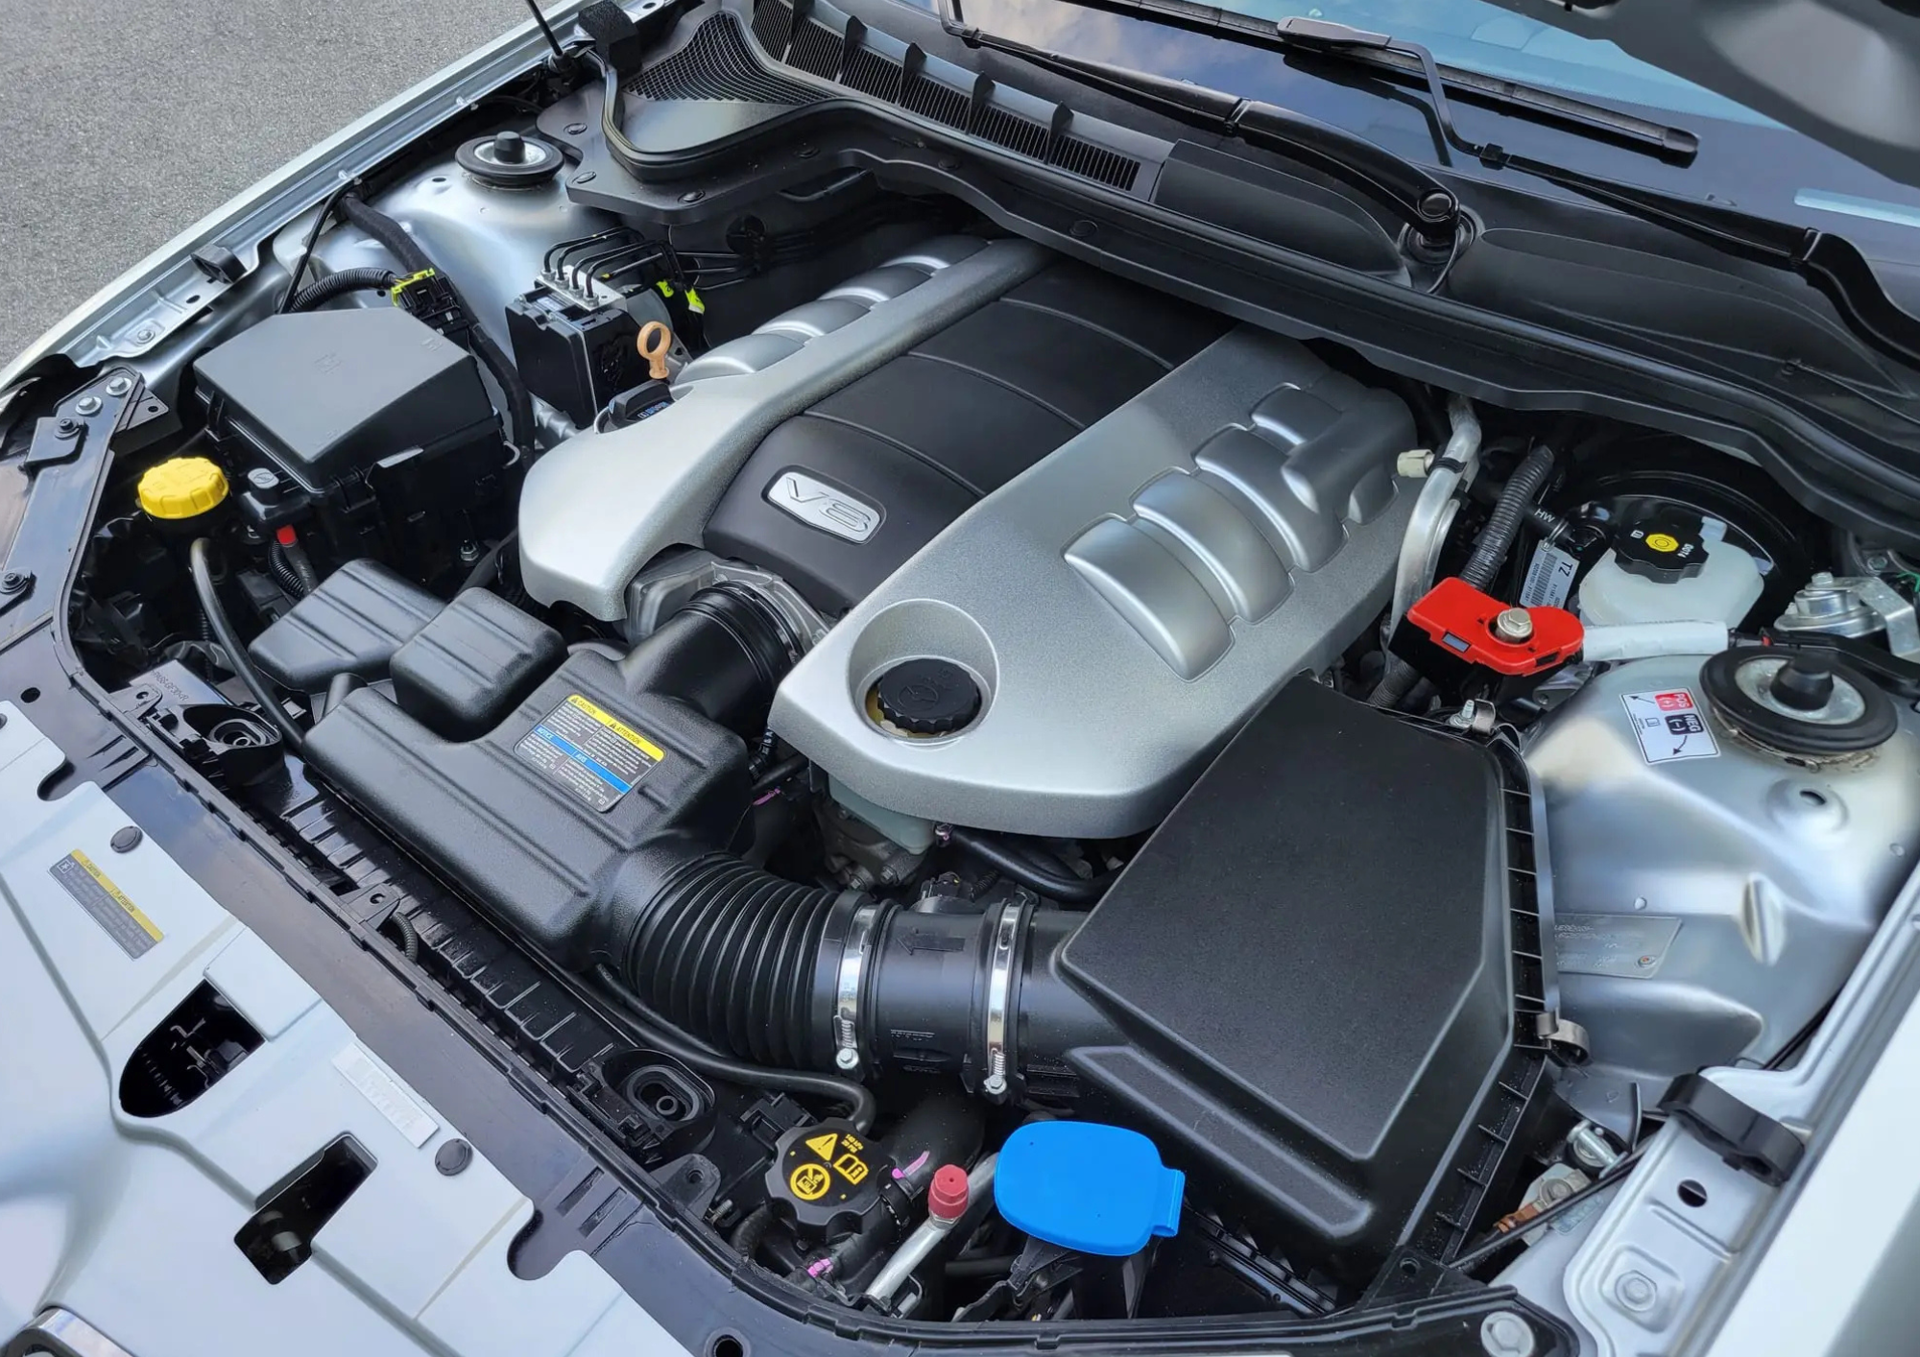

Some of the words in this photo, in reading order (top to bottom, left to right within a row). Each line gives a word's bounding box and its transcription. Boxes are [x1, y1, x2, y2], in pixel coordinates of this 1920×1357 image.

[786, 477, 871, 532] V8
[1534, 508, 1556, 523] HW
[1558, 561, 1574, 577] TZ
[577, 700, 598, 715] CAUTION
[1674, 693, 1691, 707] POS
[1683, 714, 1702, 732] NEG
[537, 726, 554, 740] NOTICE
[616, 723, 643, 745] ATTENTION
[86, 863, 101, 878] CAUTION
[118, 895, 136, 913] ATTENTION
